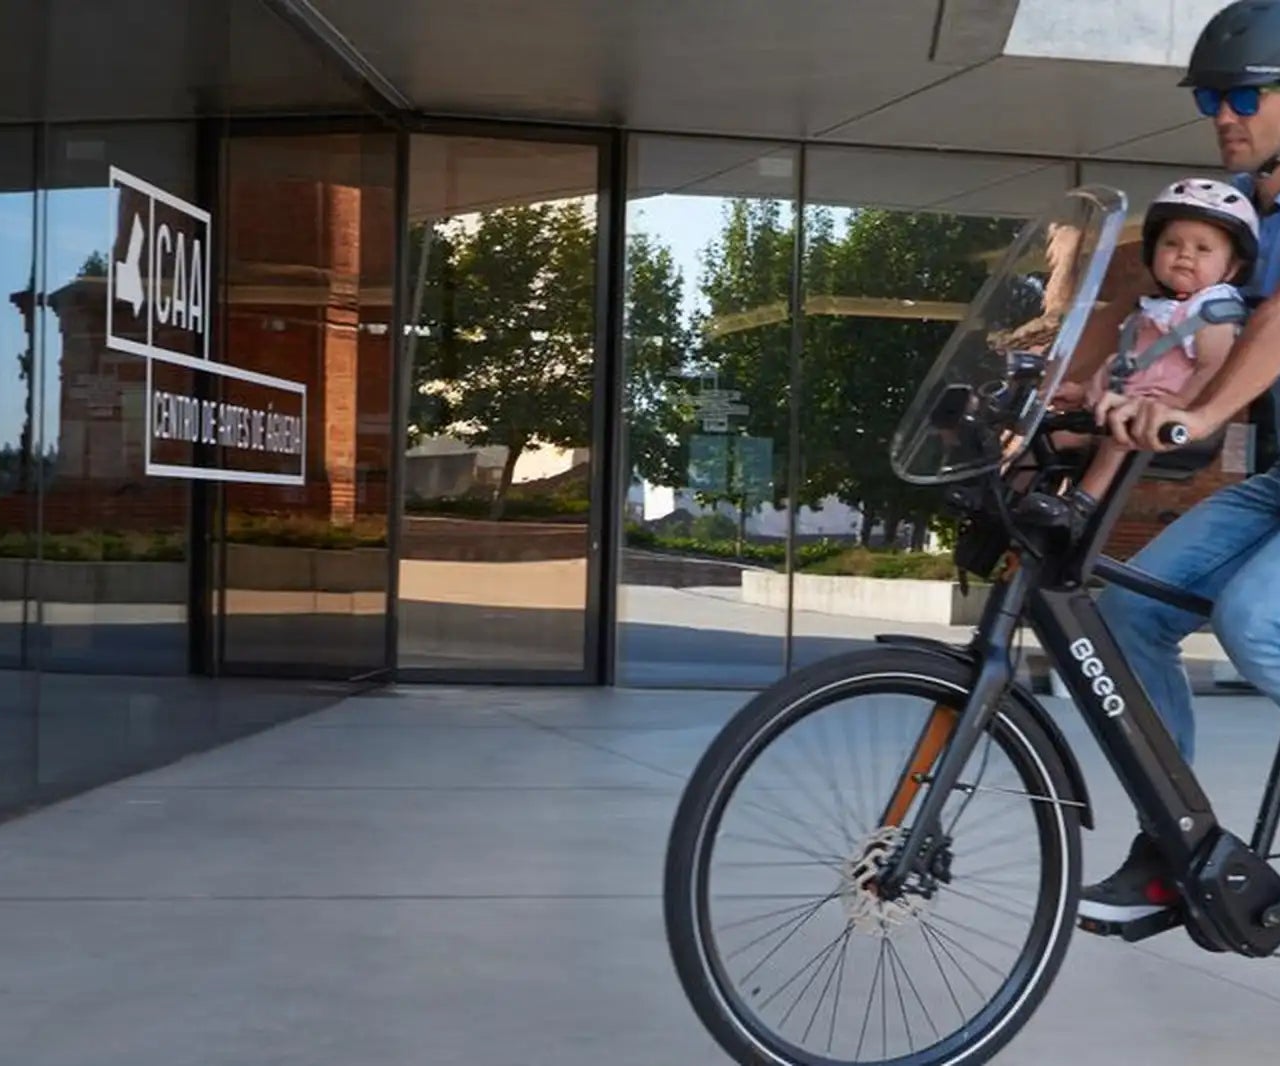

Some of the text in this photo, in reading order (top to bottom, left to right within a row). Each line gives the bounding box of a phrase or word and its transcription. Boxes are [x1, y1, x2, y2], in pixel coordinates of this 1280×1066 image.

[155, 223, 203, 333] CAA
[154, 391, 199, 441] CENTRO
[201, 400, 216, 444] DE
[219, 403, 249, 449] ARTES
[251, 409, 264, 450] DE
